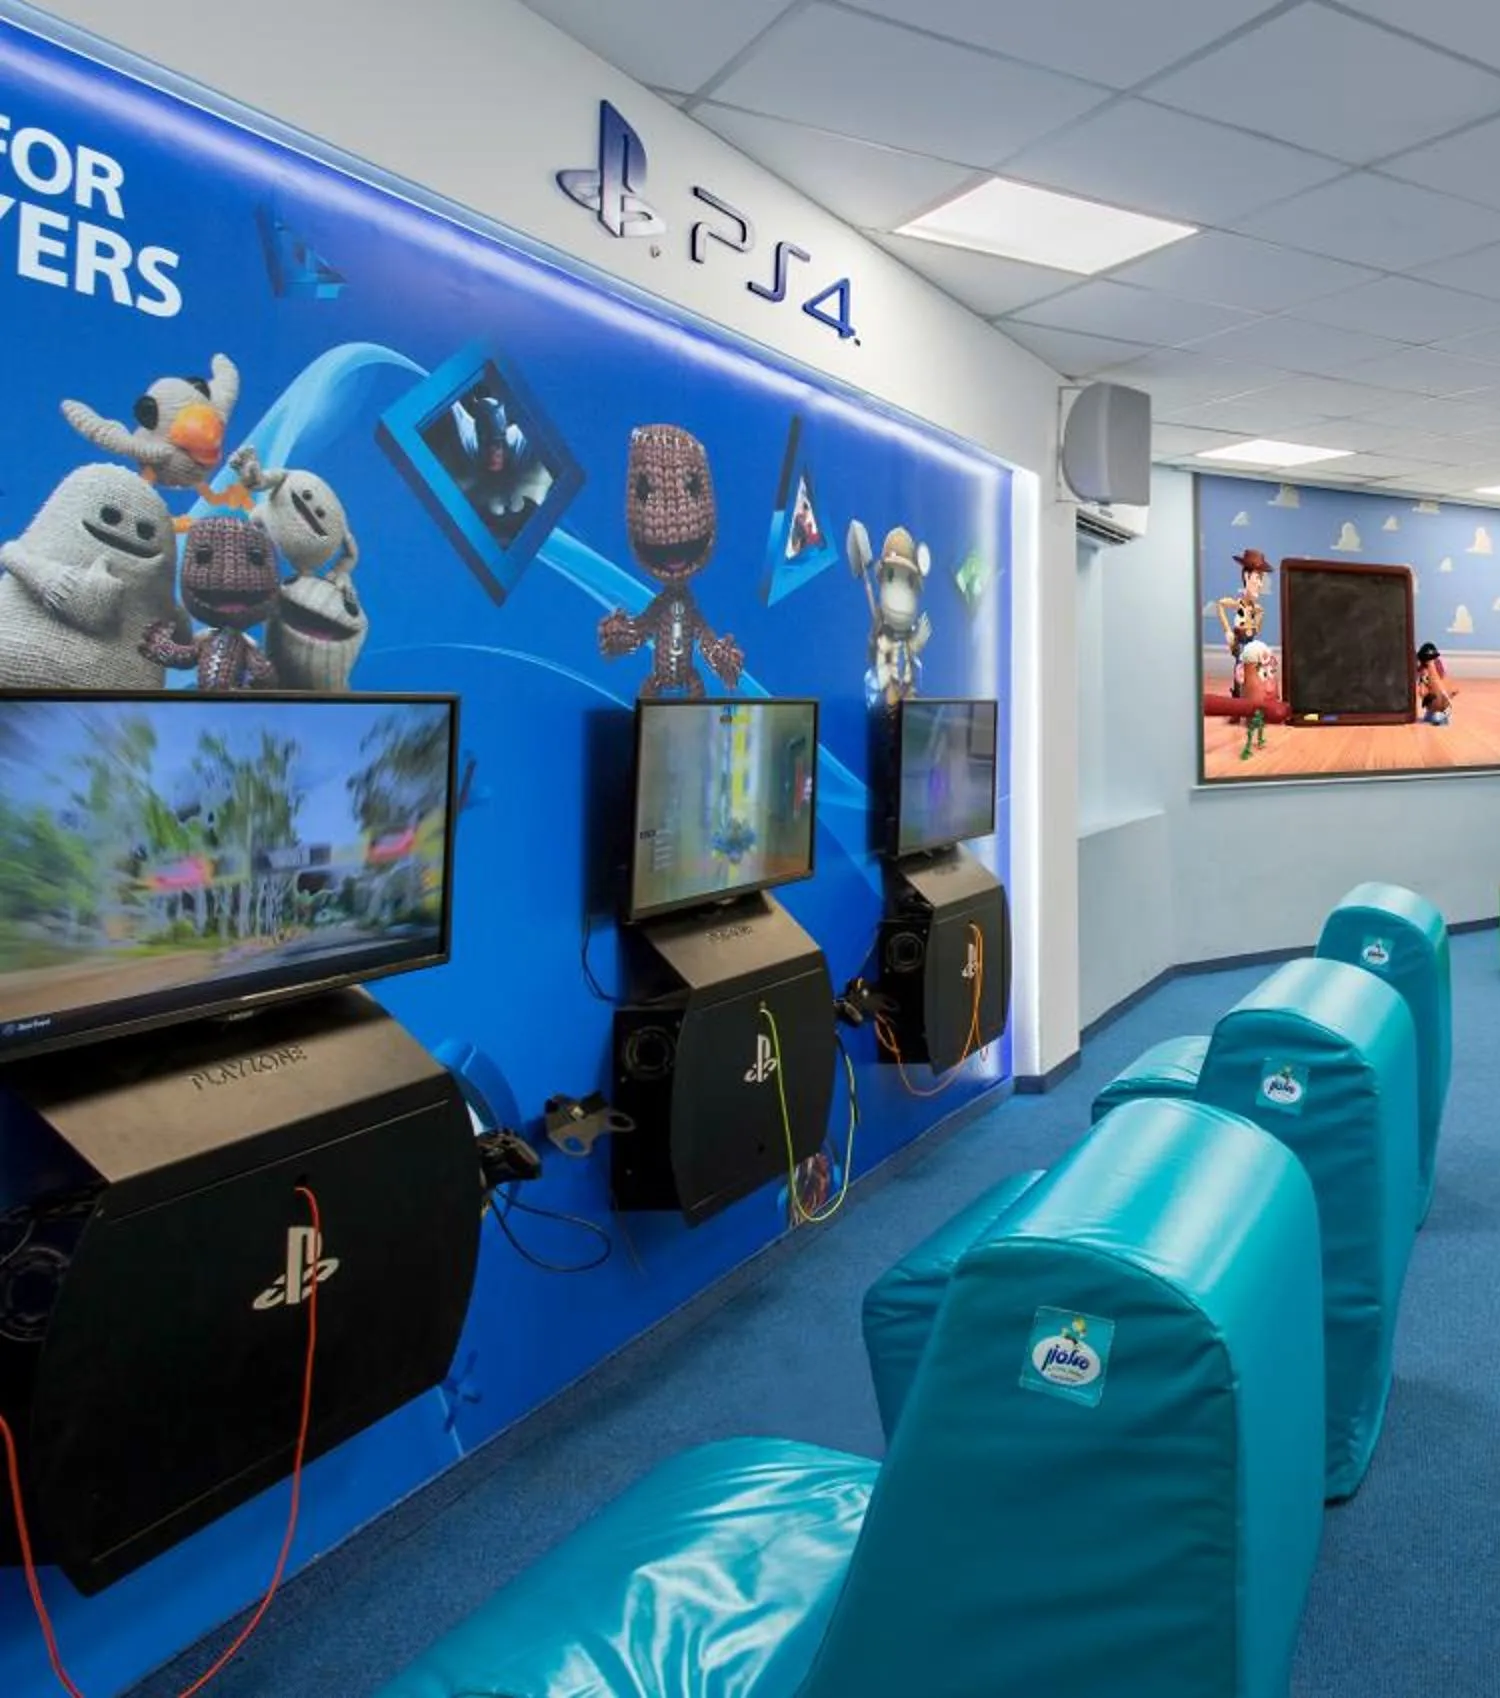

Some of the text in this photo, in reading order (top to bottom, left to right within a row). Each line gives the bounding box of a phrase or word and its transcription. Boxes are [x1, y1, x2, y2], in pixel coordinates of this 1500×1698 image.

[0, 113, 125, 220] OR
[0, 193, 183, 318] ERS
[690, 185, 857, 339] PS4
